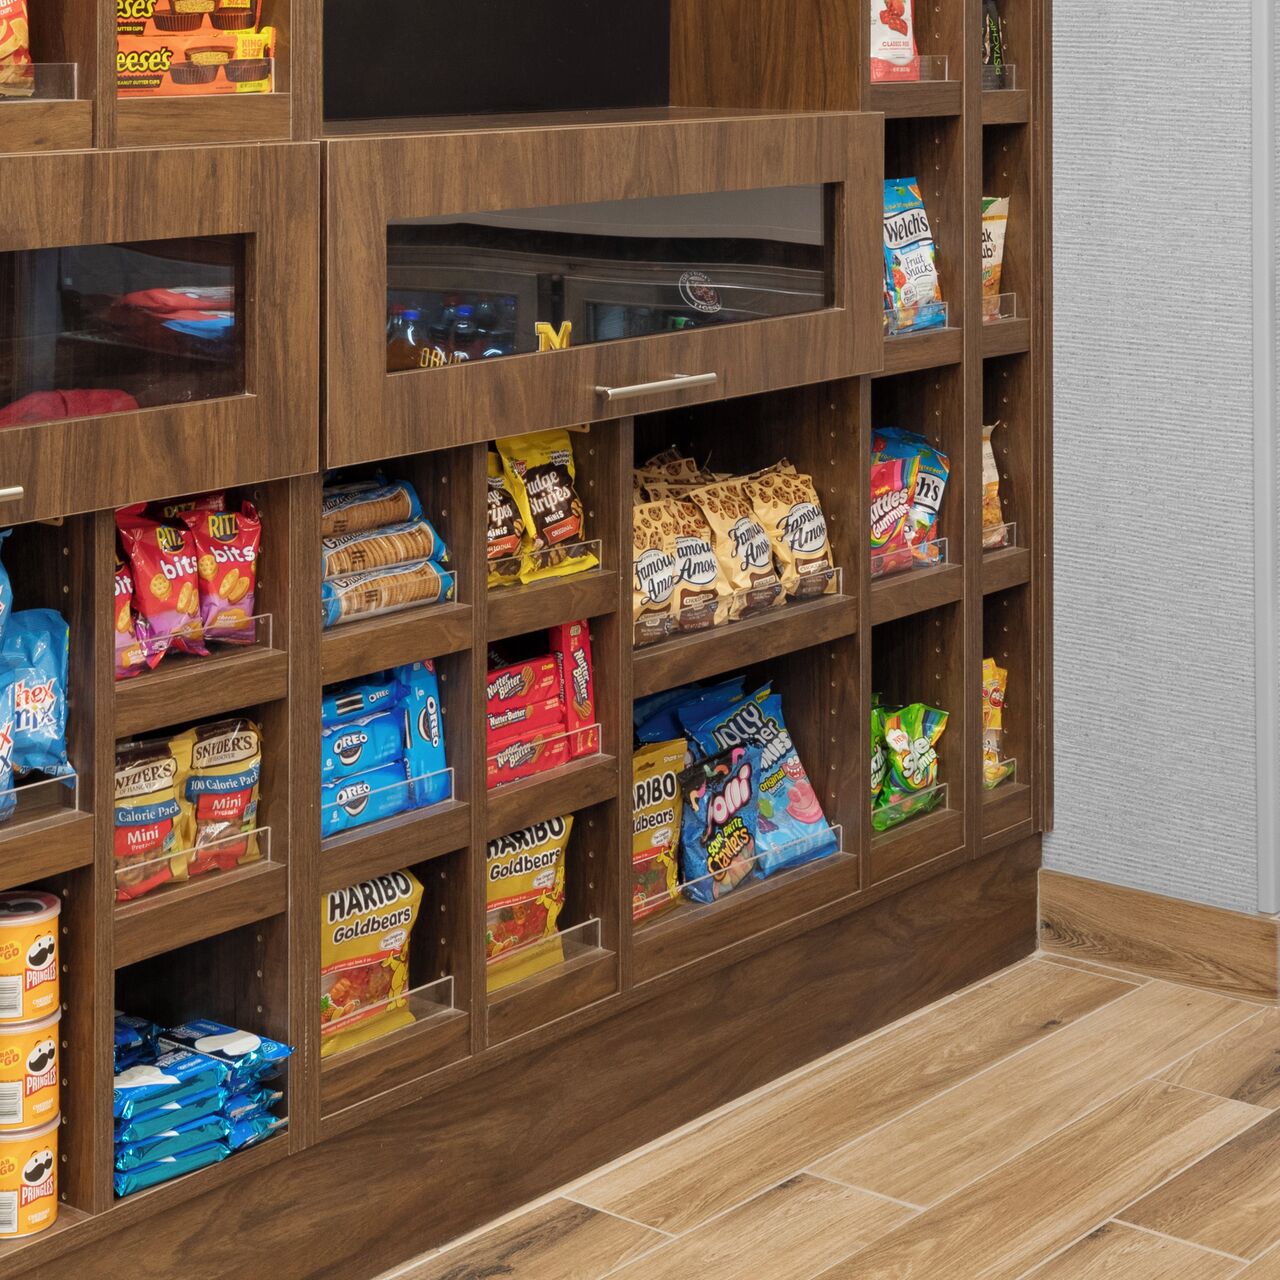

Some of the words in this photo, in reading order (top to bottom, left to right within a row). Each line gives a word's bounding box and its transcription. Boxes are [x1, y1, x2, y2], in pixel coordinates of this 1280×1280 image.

[241, 39, 263, 49] KING
[884, 213, 929, 243] Welch's
[904, 261, 934, 280] Snacks
[905, 253, 926, 270] Fruit
[208, 513, 240, 538] RITZ
[775, 504, 824, 543] Famous
[872, 503, 911, 539] Gummies
[788, 522, 827, 551] Amos
[210, 545, 257, 564] bits
[368, 689, 390, 704] OREO
[486, 673, 511, 700] Nutter
[498, 674, 522, 700] Butter
[425, 696, 440, 748] OREO
[715, 703, 763, 750] JOLLY
[195, 734, 254, 761] SNYDER'S
[334, 733, 369, 756] OREO
[759, 769, 786, 792] original
[118, 805, 157, 822] Calorie
[158, 794, 181, 813] Pack
[211, 794, 243, 811] Mini
[336, 784, 372, 806] OREO
[126, 825, 160, 846] Mini
[131, 840, 157, 851] Pretzels
[707, 833, 724, 857] SOUR
[489, 847, 562, 882] Goldbears
[706, 826, 752, 882] Crawlers
[329, 870, 413, 923] HARIBO
[332, 906, 412, 944] Goldbears
